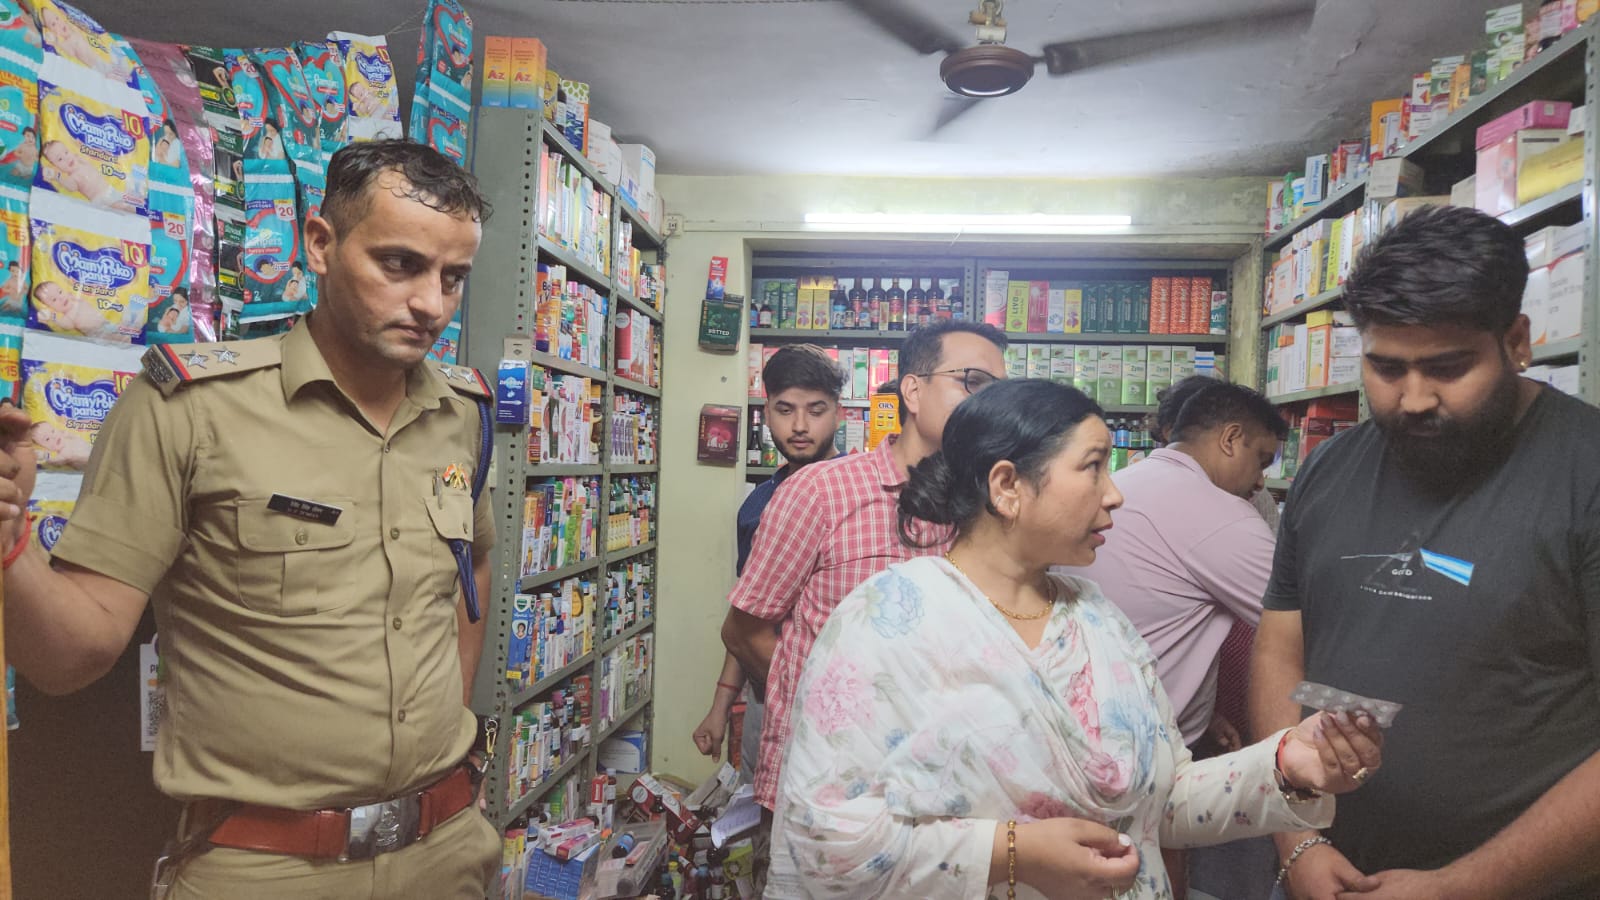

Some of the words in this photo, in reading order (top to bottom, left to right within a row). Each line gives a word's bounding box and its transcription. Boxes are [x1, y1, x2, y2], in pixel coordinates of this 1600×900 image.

[122, 112, 141, 136] 10
[278, 206, 294, 217] 20
[168, 222, 185, 235] 20
[59, 243, 132, 278] MamyPoko
[123, 242, 144, 265] 10
[53, 381, 119, 409] MamyPok
[66, 420, 101, 430] Standar
